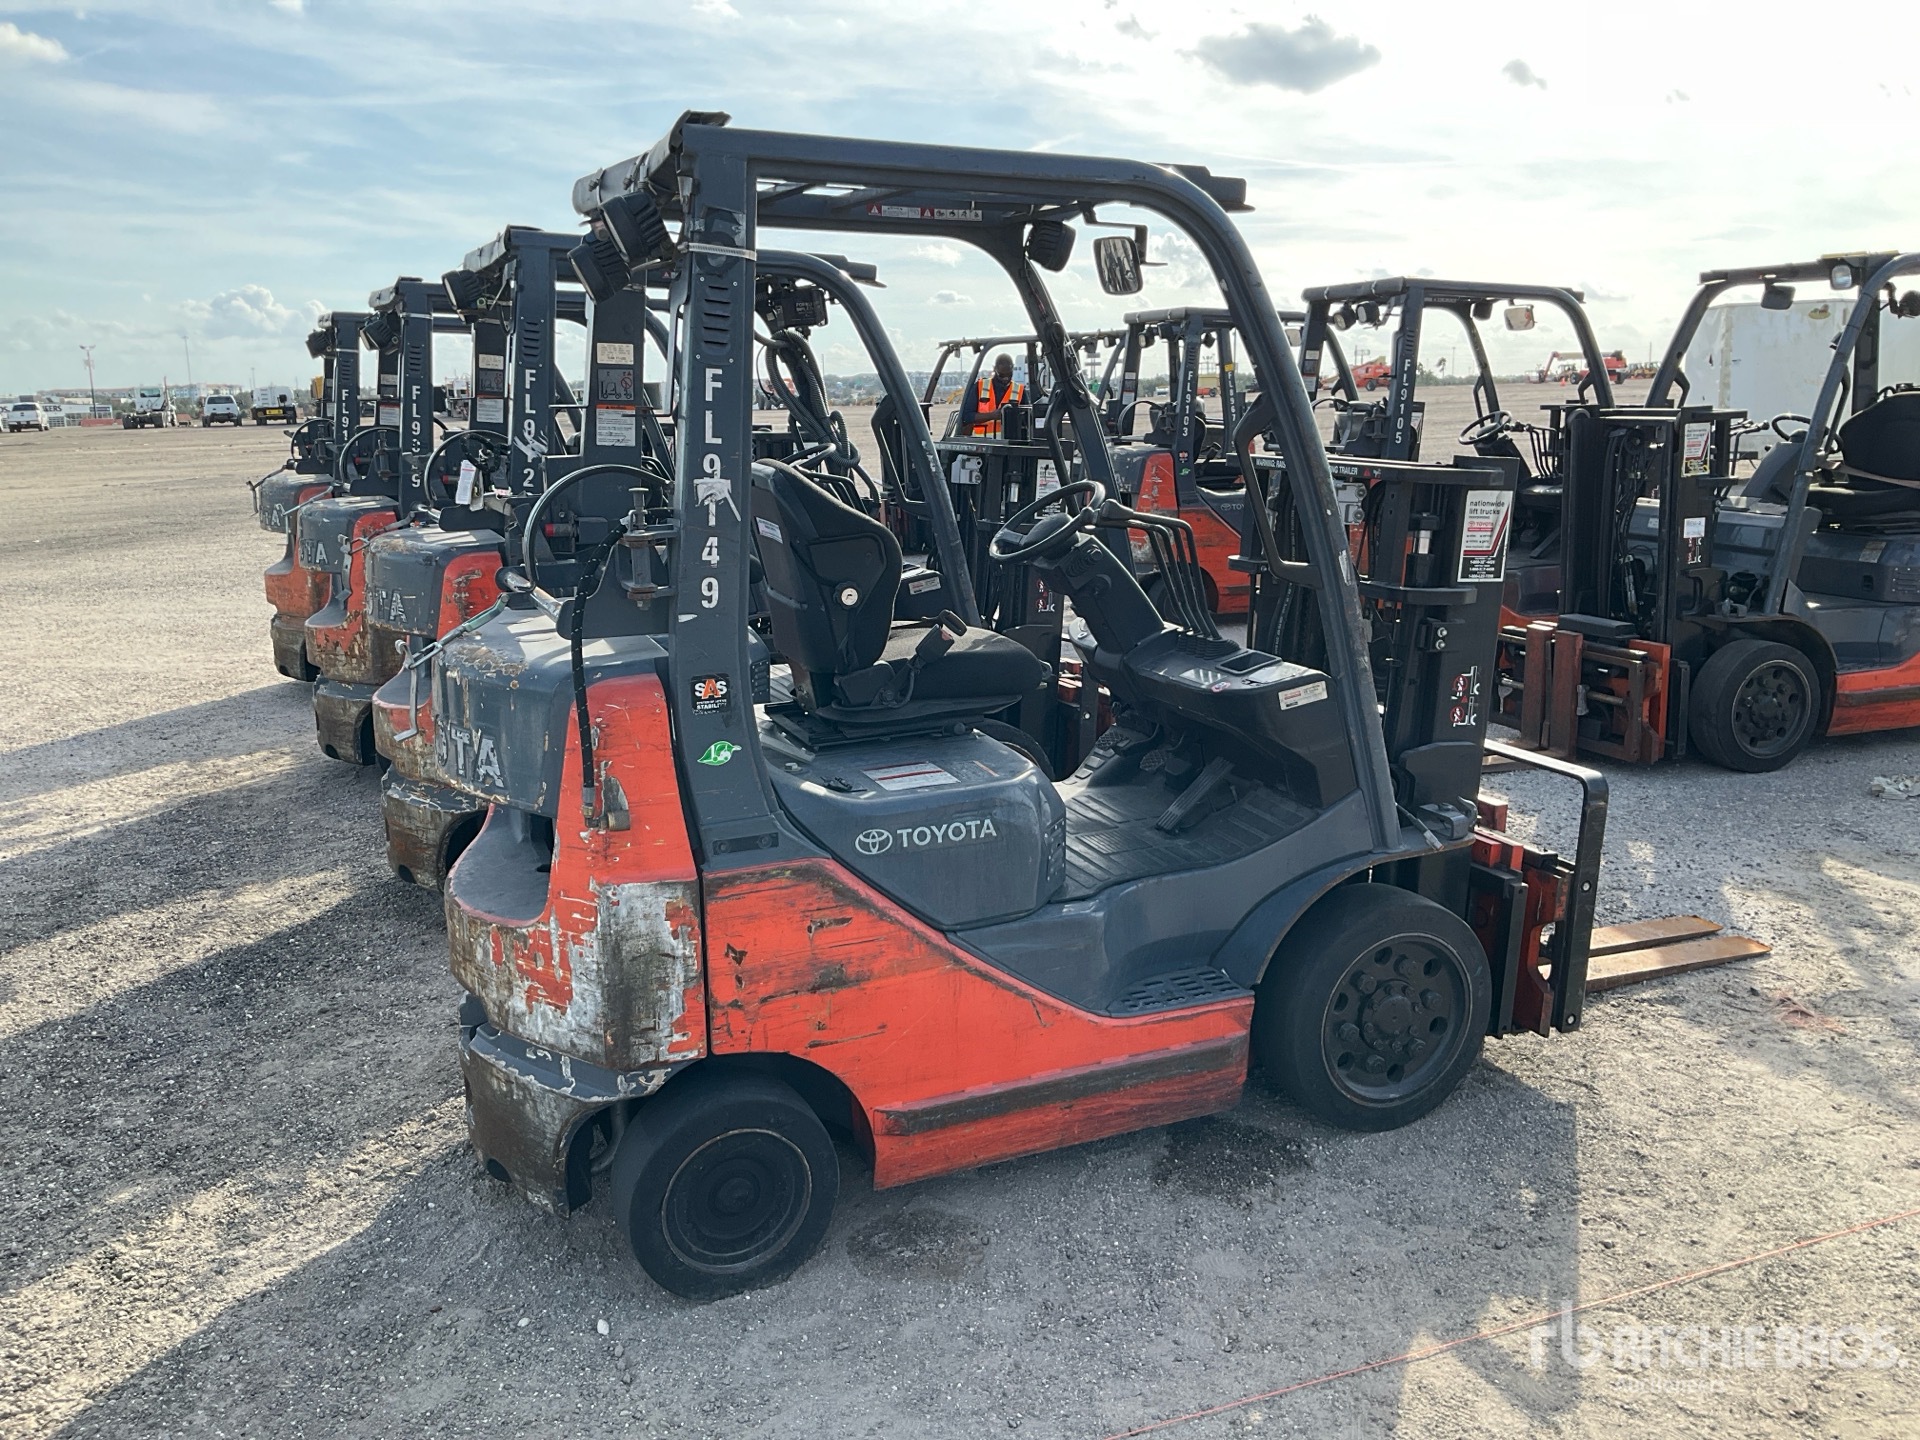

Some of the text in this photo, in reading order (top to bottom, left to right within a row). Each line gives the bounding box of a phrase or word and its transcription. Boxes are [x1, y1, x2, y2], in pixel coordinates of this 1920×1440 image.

[1182, 370, 1194, 437] FL9103
[1394, 358, 1411, 444] FL9105
[1339, 465, 1358, 475] TRAILER
[694, 678, 728, 699] SAS
[896, 818, 997, 848] TOYOTA
